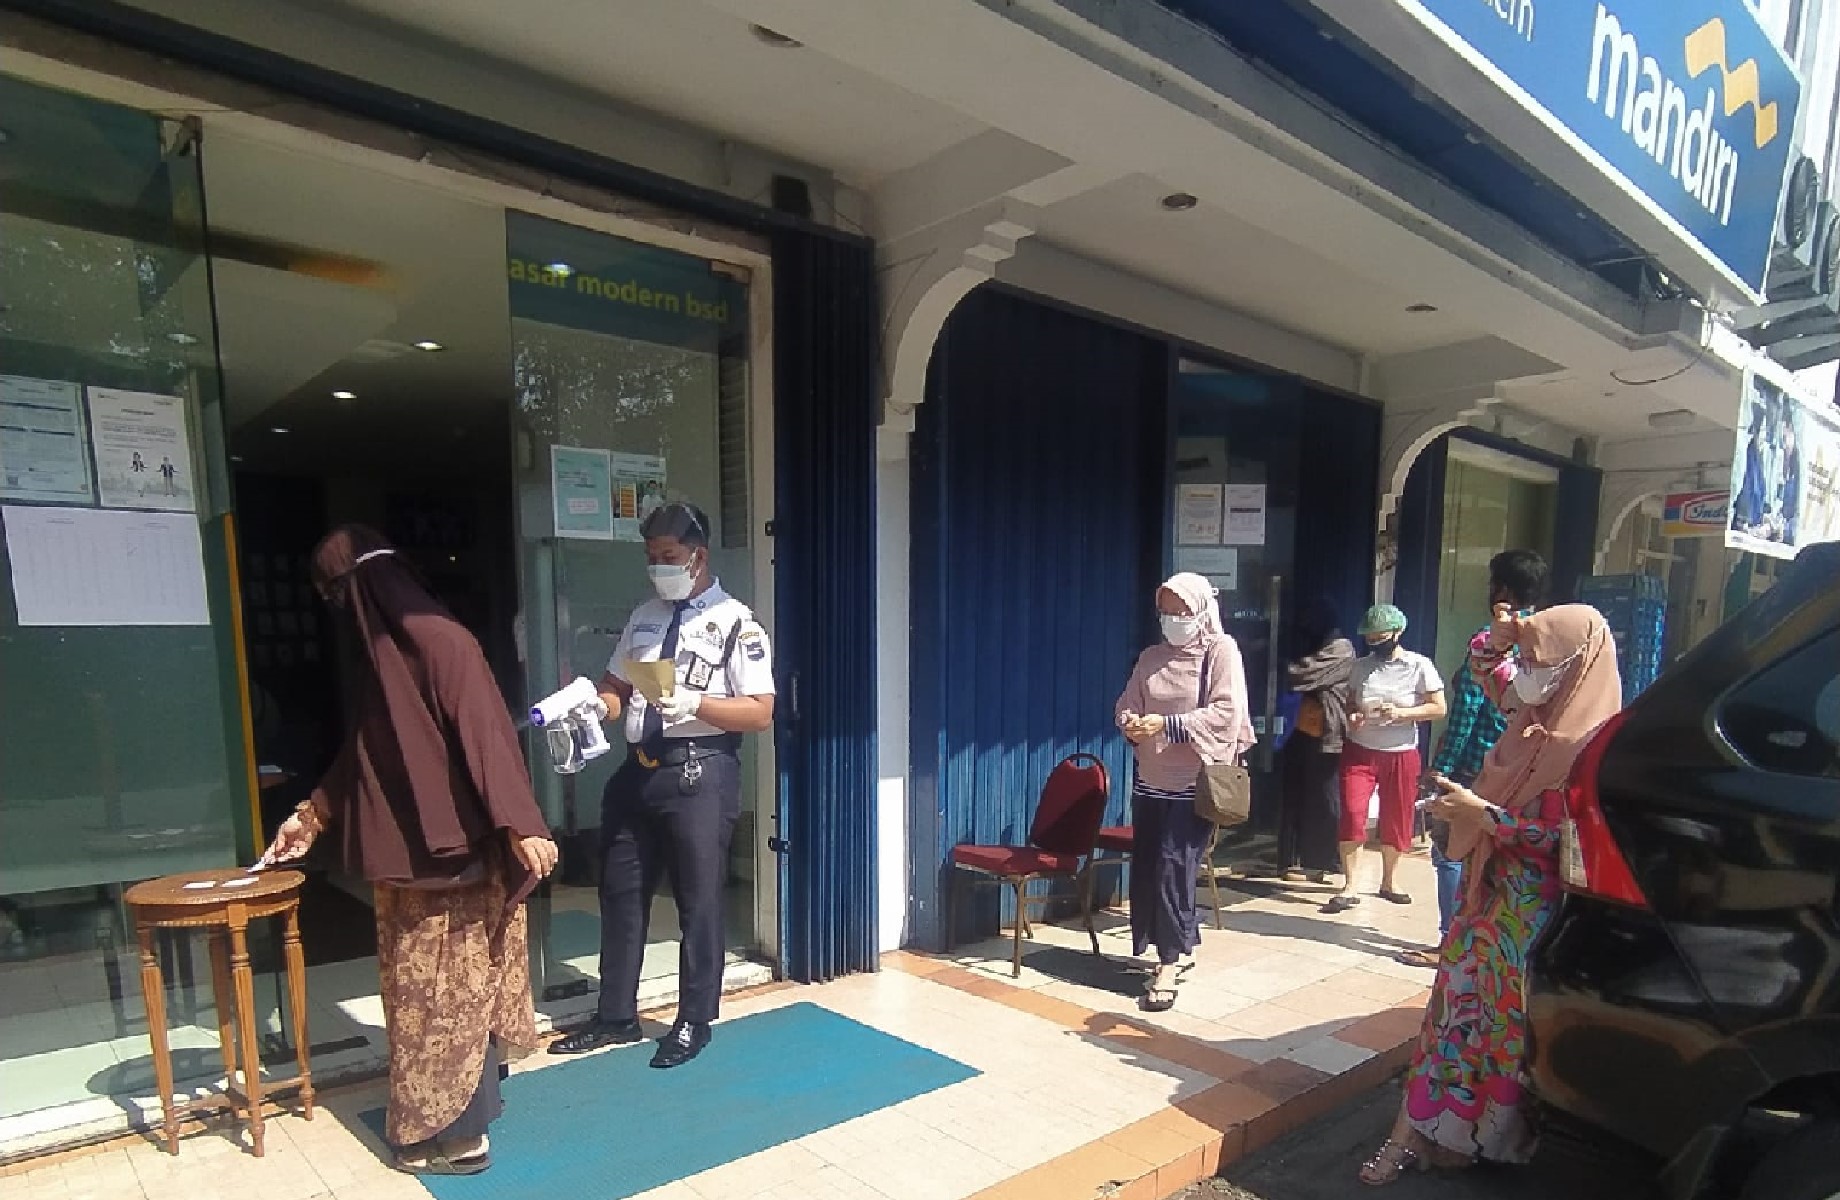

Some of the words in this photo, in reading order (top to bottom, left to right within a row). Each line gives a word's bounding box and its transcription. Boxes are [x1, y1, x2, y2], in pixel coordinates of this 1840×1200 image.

[1586, 3, 1739, 226] mandiri
[576, 274, 680, 314] modern
[684, 291, 727, 321] bsd
